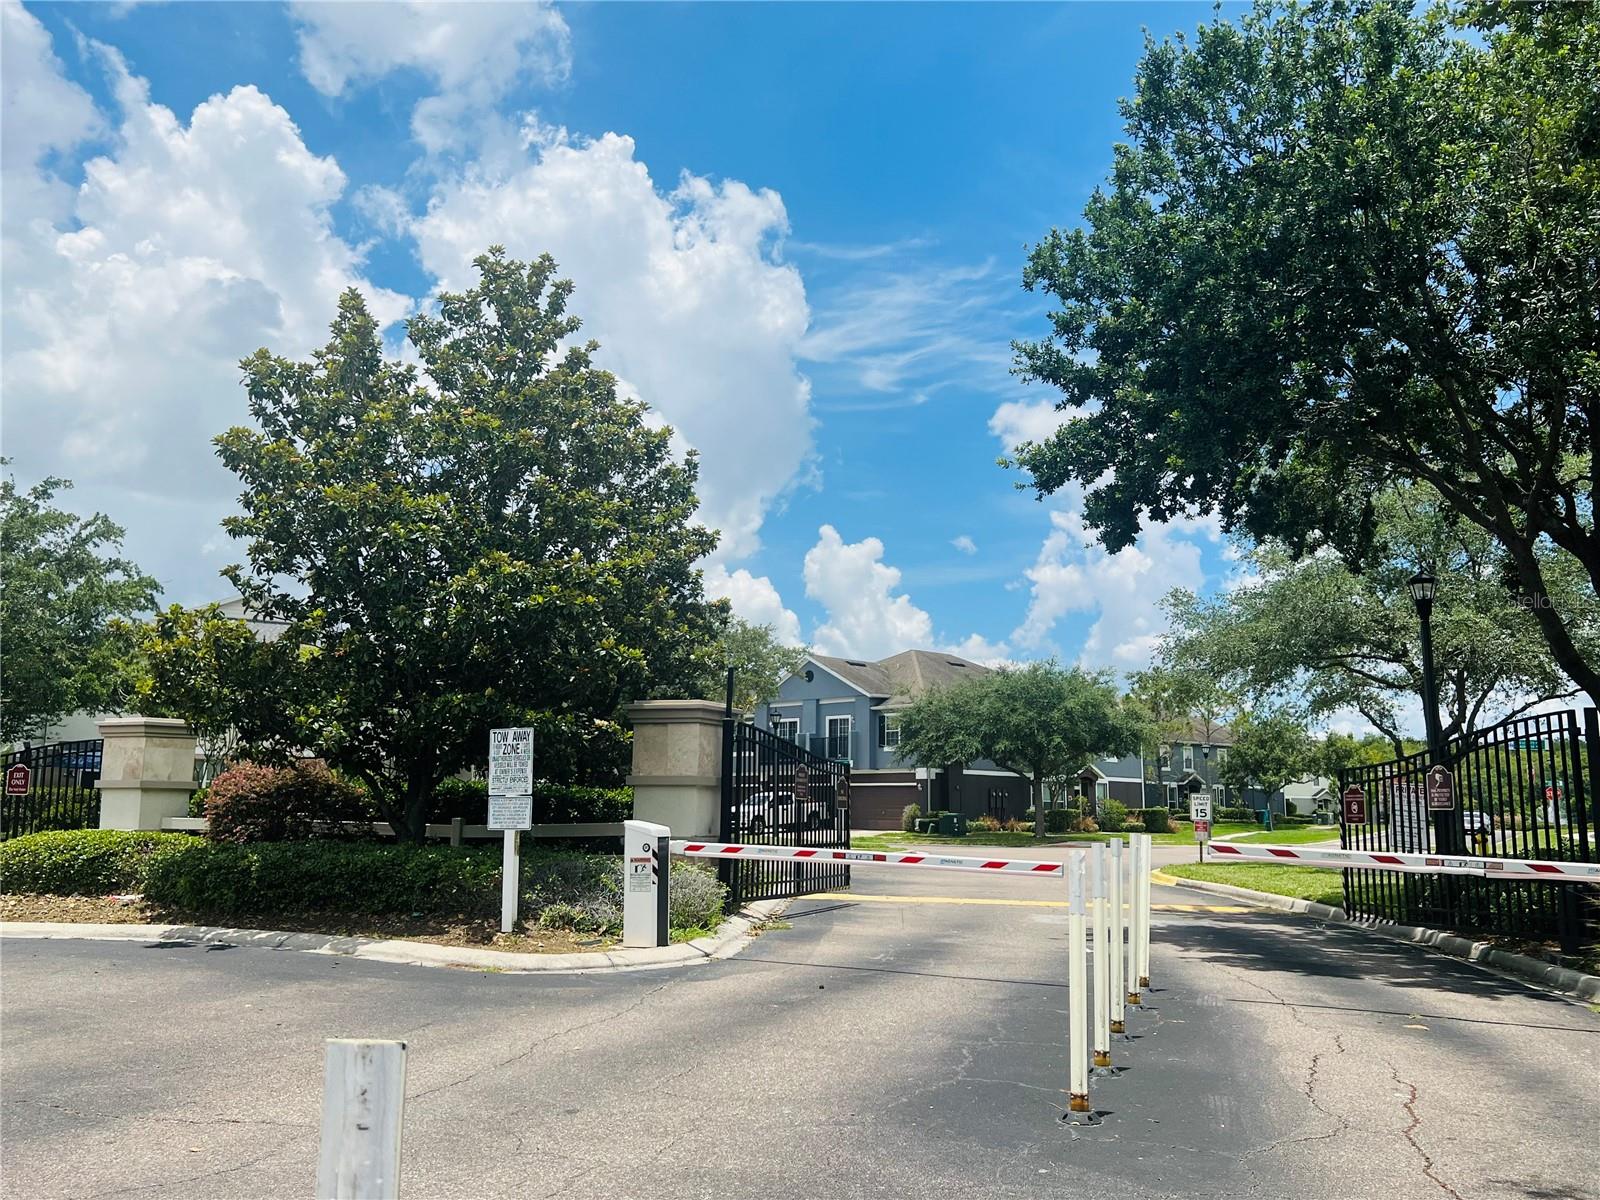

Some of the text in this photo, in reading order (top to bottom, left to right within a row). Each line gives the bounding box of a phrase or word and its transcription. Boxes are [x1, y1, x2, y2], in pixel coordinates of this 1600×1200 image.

[493, 730, 531, 743] TOW AWAY
[502, 743, 521, 755] ZONE
[1395, 786, 1424, 795] PRIAE
[1195, 808, 1207, 817] 15
